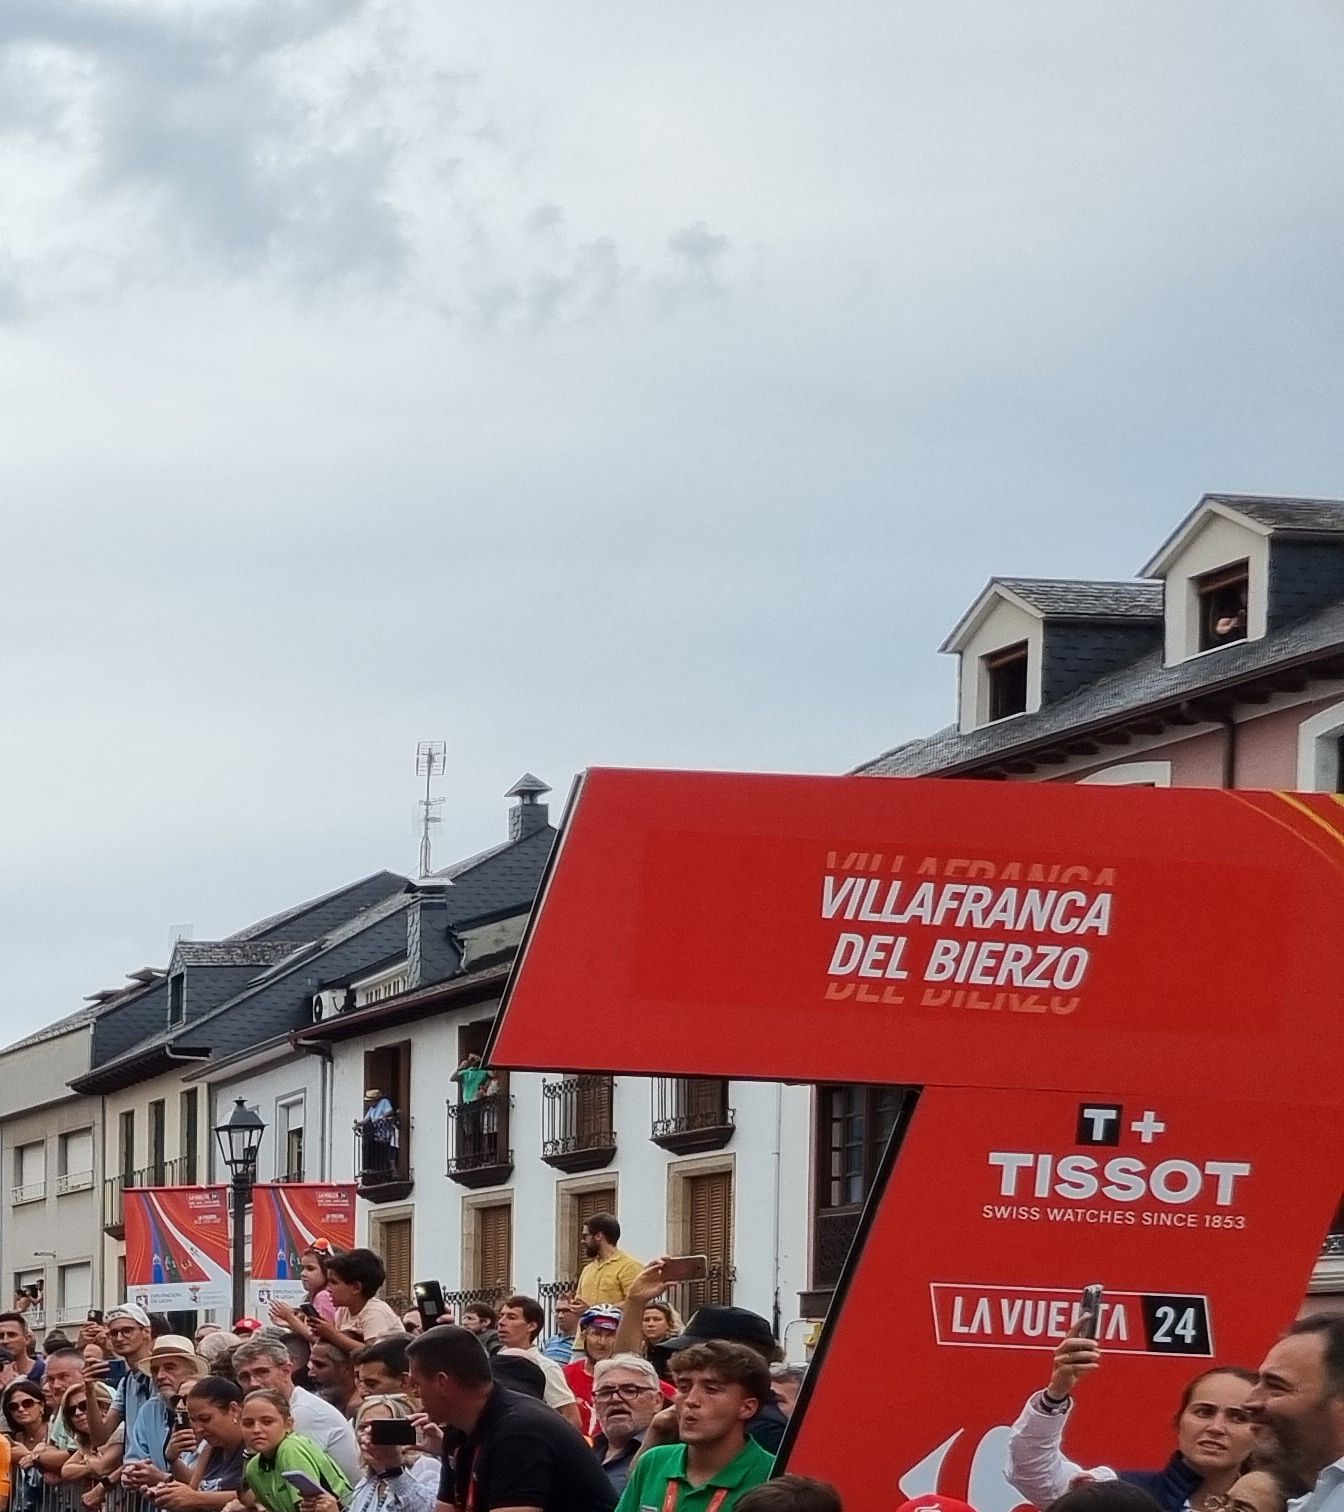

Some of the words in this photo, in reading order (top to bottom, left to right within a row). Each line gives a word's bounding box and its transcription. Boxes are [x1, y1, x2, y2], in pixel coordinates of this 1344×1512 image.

[821, 876, 1113, 936] VILLAFRANCA
[828, 933, 909, 980] DEL
[923, 939, 1090, 990] BIERZO
[988, 1152, 1251, 1206] TISSOT
[982, 1204, 1041, 1220] SWISS
[1046, 1207, 1135, 1225] WATCHES
[1141, 1211, 1199, 1228] SINCE
[1204, 1214, 1246, 1230] 1853
[953, 1296, 992, 1335] LA
[1153, 1306, 1196, 1344] 24
